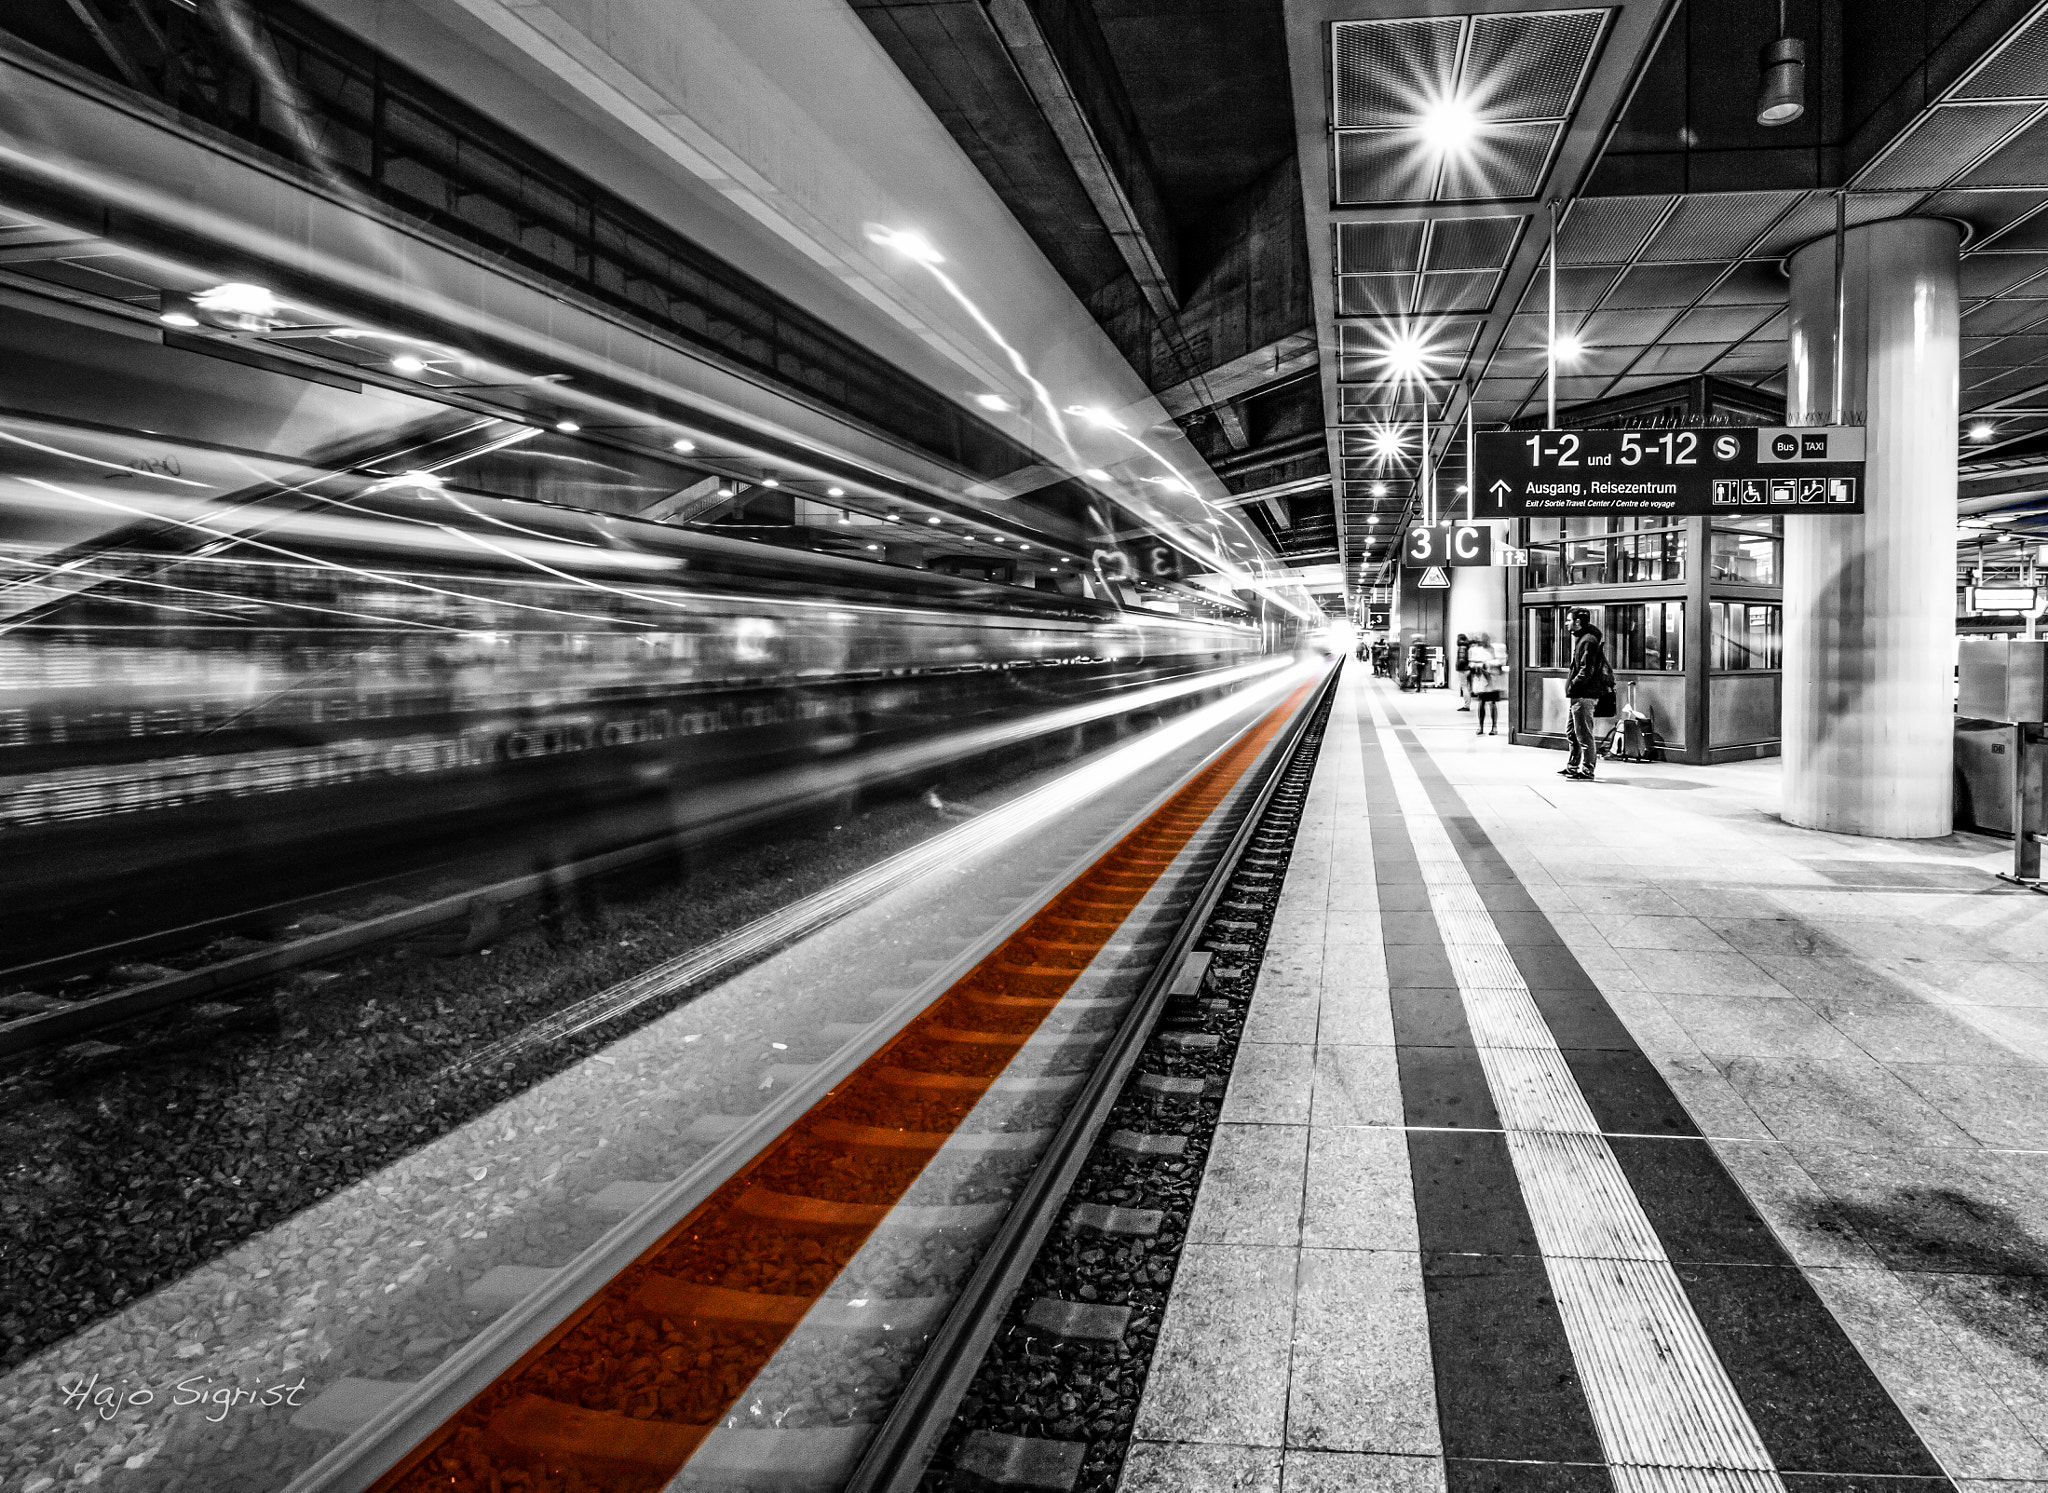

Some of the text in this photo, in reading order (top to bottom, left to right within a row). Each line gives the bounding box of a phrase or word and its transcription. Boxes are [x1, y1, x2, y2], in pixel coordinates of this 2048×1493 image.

[1525, 431, 1697, 467] 1-2 und 5-12
[1717, 437, 1736, 459] S
[1777, 442, 1795, 451] Bus
[1805, 441, 1824, 451] TAXI
[1591, 481, 1677, 494] Reisezentrum
[1525, 500, 1539, 508] Exit
[1544, 499, 1565, 508] Sortie
[1566, 499, 1586, 507] Travel
[1588, 499, 1609, 507] Center
[1615, 499, 1637, 508] Centre
[1639, 499, 1649, 508] de
[1650, 500, 1675, 510] voyage
[1410, 528, 1432, 559] 3
[1455, 526, 1479, 559] C
